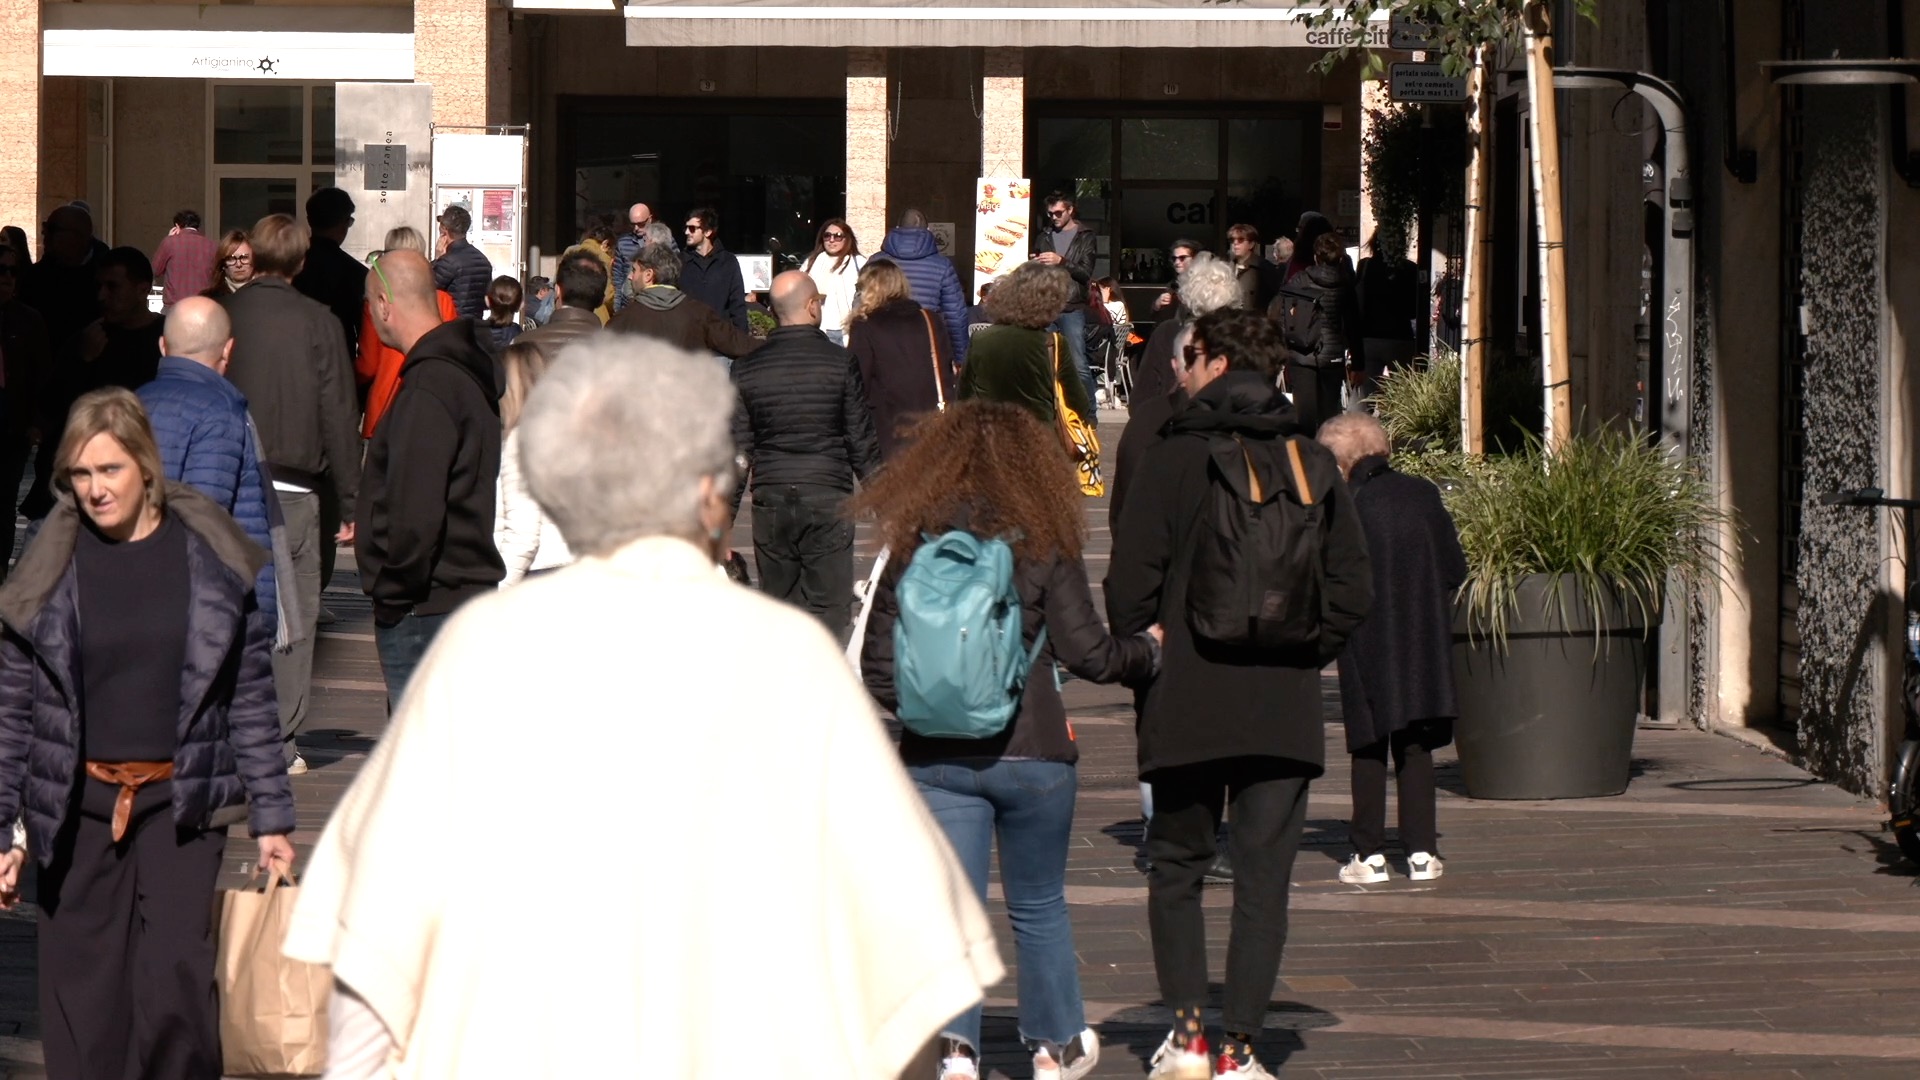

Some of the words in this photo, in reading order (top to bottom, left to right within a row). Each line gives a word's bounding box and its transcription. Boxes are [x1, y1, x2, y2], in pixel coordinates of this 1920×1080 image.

[1305, 27, 1355, 45] caffè
[191, 57, 254, 69] Artigianino
[705, 81, 711, 90] 9
[1167, 84, 1176, 93] 10
